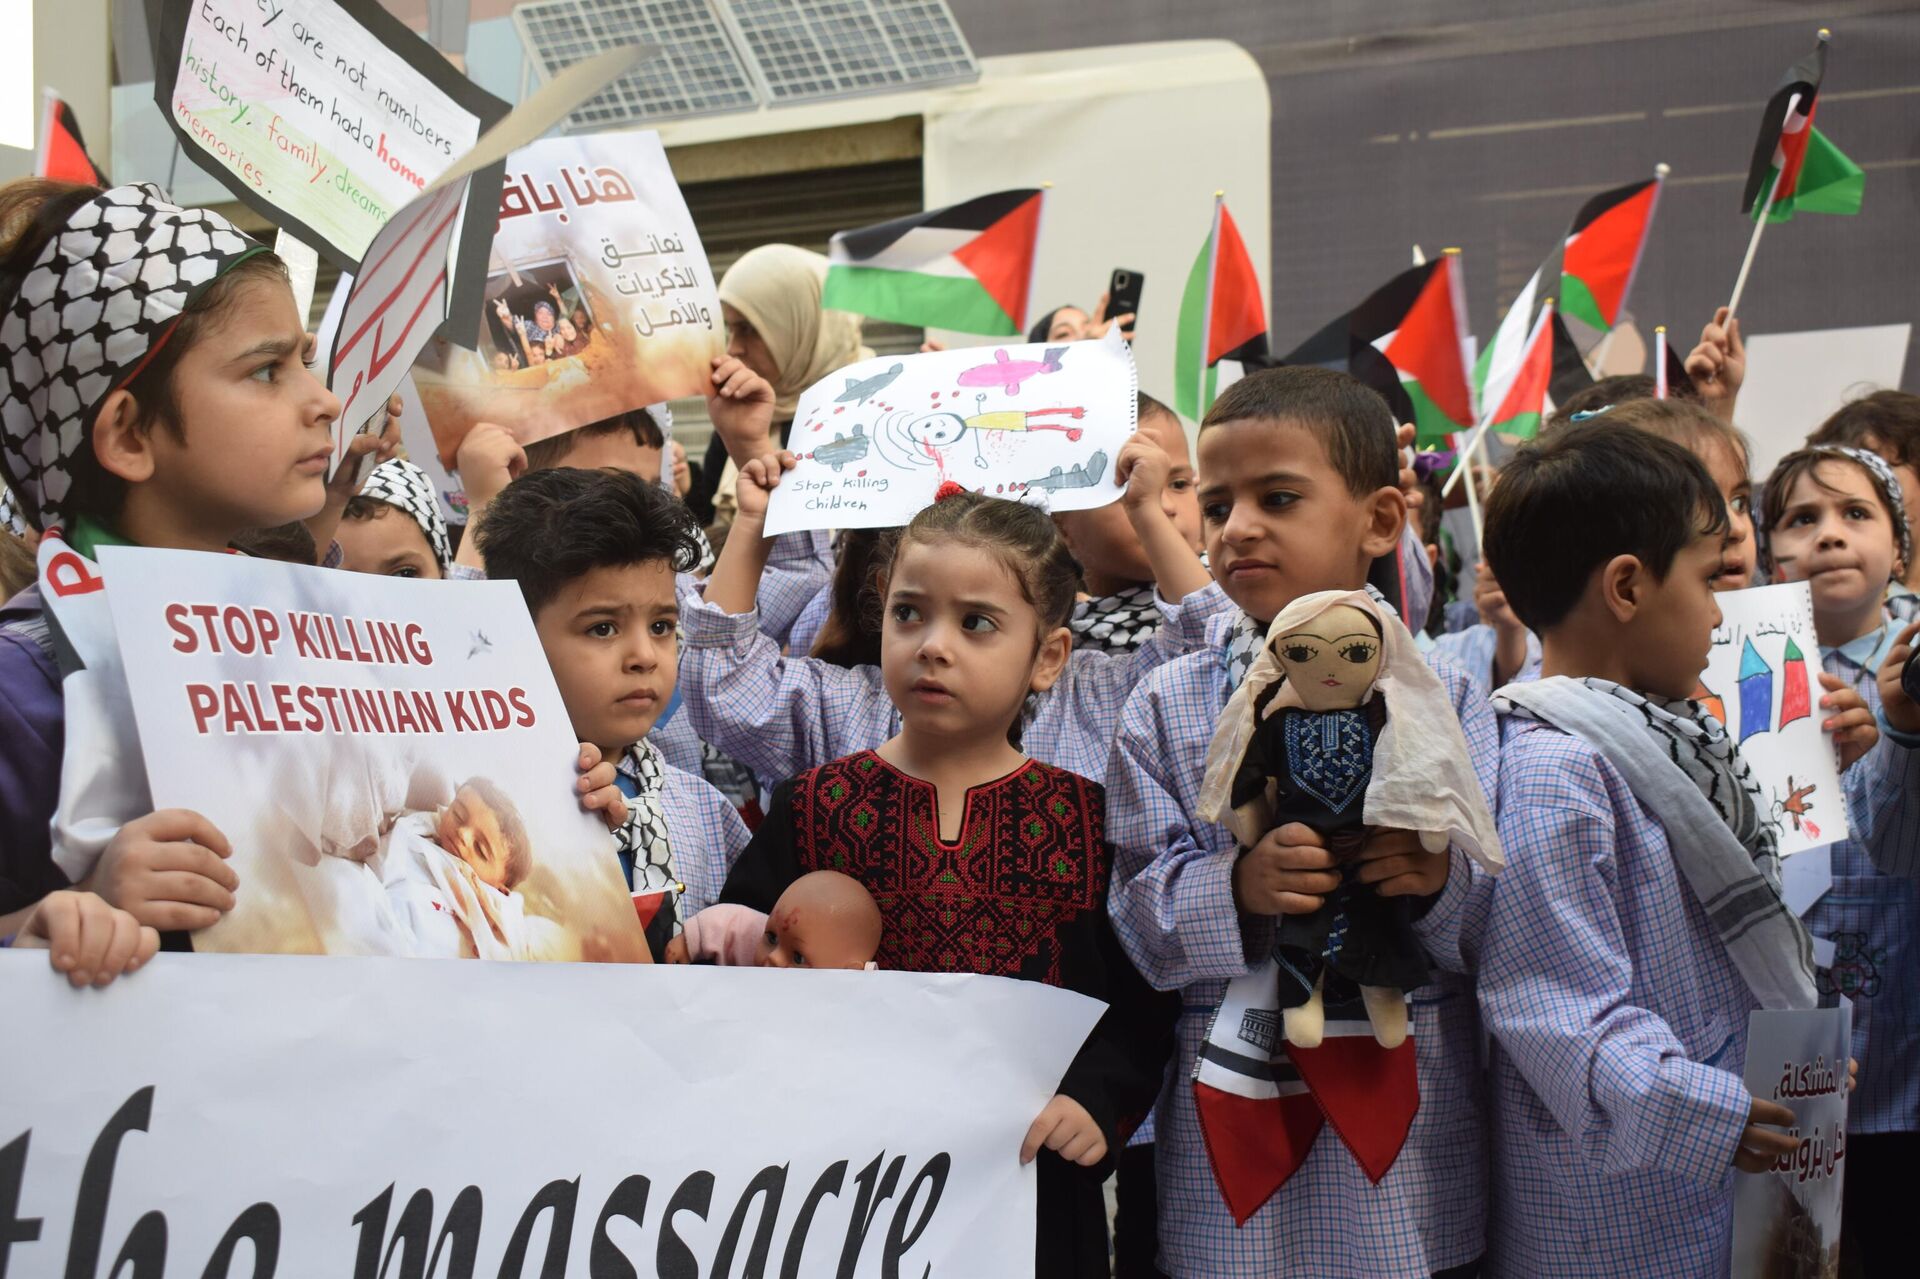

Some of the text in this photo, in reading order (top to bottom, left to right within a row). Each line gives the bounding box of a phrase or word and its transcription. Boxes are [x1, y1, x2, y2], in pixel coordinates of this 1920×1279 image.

[258, 0, 283, 27] ey
[293, 22, 323, 60] are
[335, 55, 367, 91] not
[201, 0, 248, 53] Each
[256, 48, 277, 72] of
[281, 60, 323, 114] them
[376, 133, 425, 192] home
[335, 167, 388, 225] dreams
[561, 167, 636, 206] هنا
[616, 266, 699, 299] الذكريات
[165, 604, 433, 666] STOP KILLING
[186, 684, 536, 734] PALESTINIAN KIDS
[352, 1149, 951, 1279] massacre
